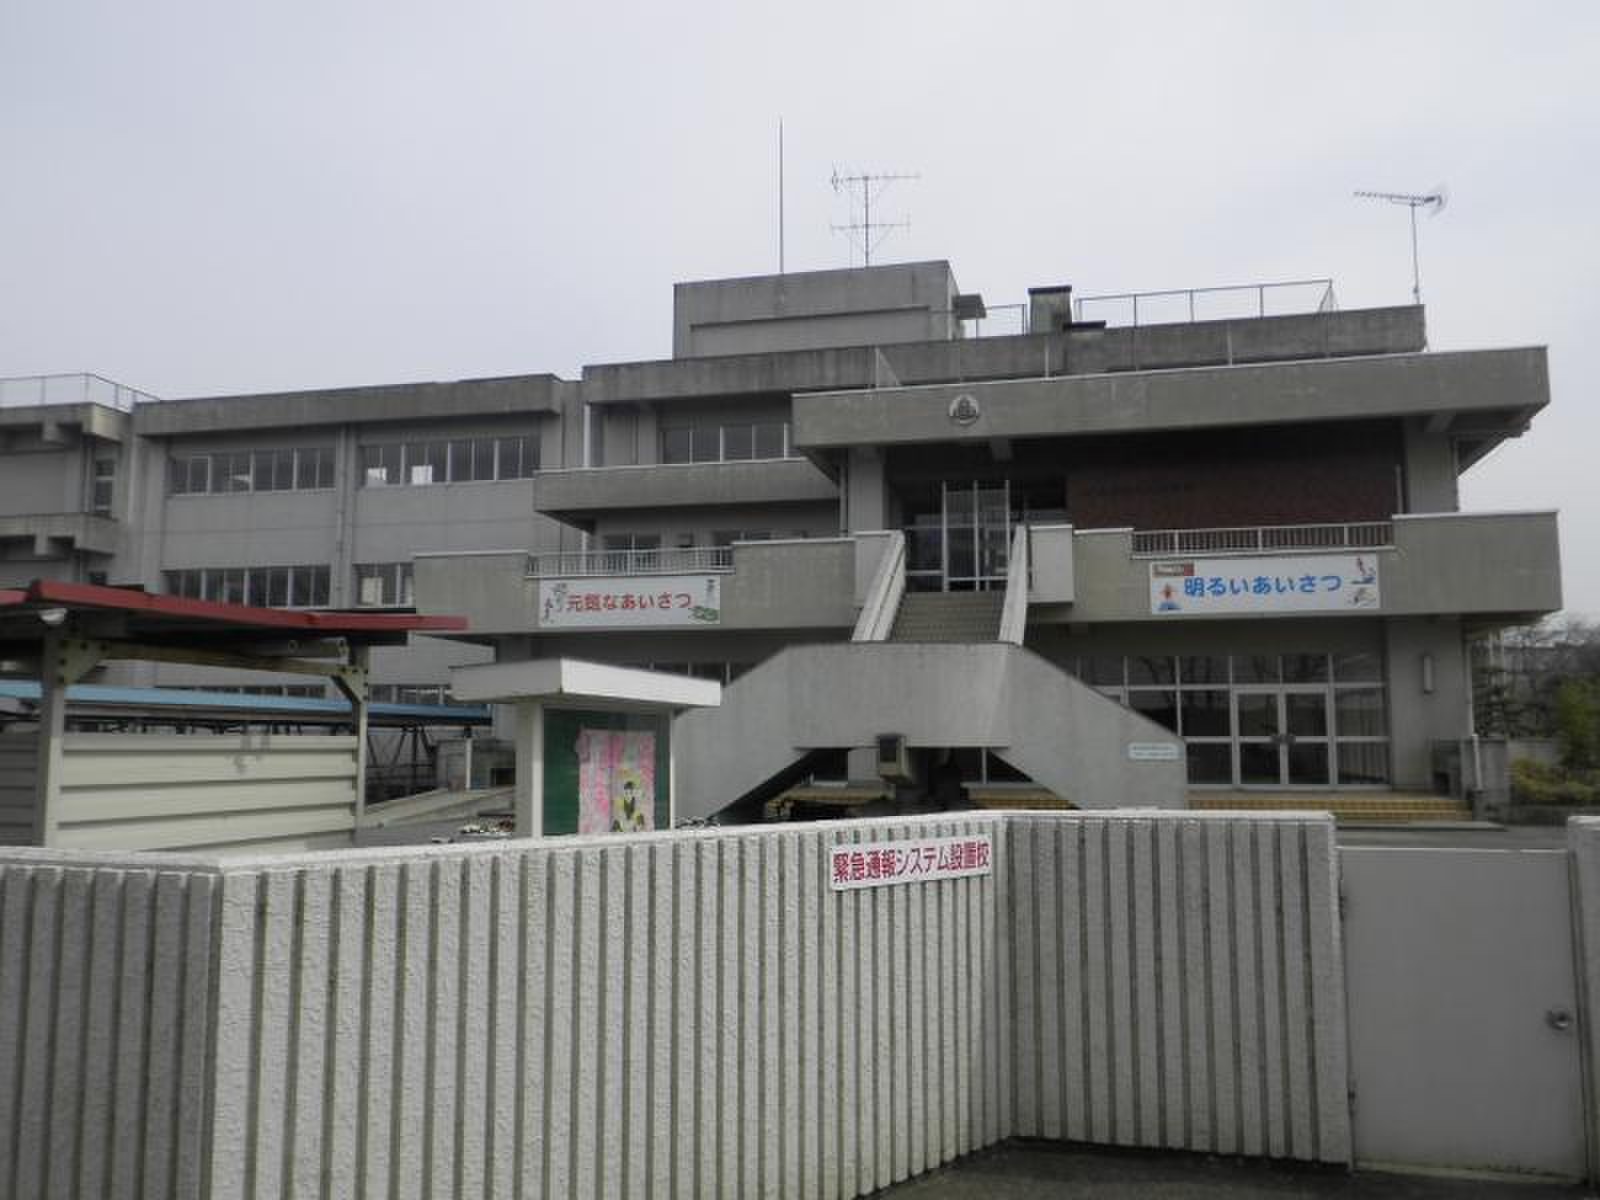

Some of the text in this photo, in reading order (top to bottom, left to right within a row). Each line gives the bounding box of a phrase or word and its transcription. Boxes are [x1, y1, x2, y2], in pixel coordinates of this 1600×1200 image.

[1184, 575, 1341, 597] 明るいあいさつ
[832, 841, 990, 883] 緊急通報システム設置校
